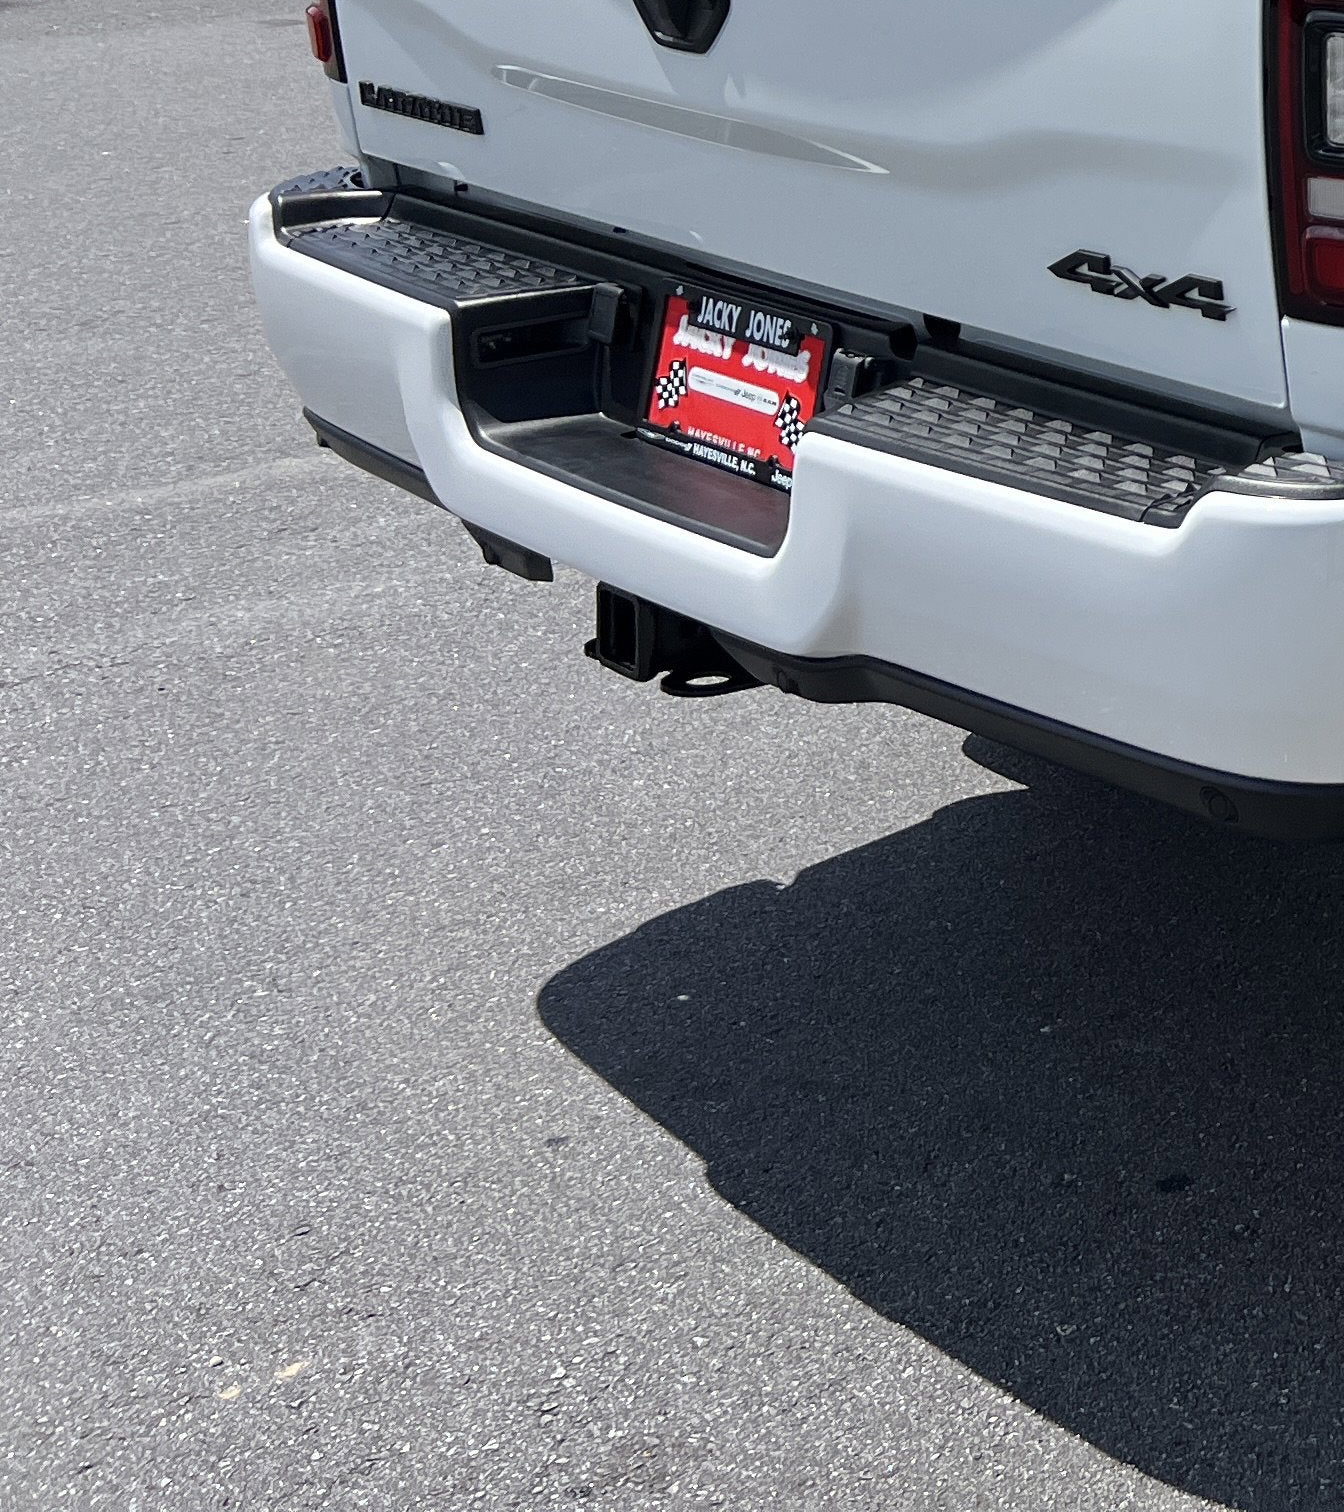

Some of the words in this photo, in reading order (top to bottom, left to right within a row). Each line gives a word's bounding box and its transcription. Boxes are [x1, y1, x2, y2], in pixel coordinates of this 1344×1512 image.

[697, 295, 742, 333] JACKY
[745, 310, 792, 348] JONES
[771, 468, 793, 491] Jeep
